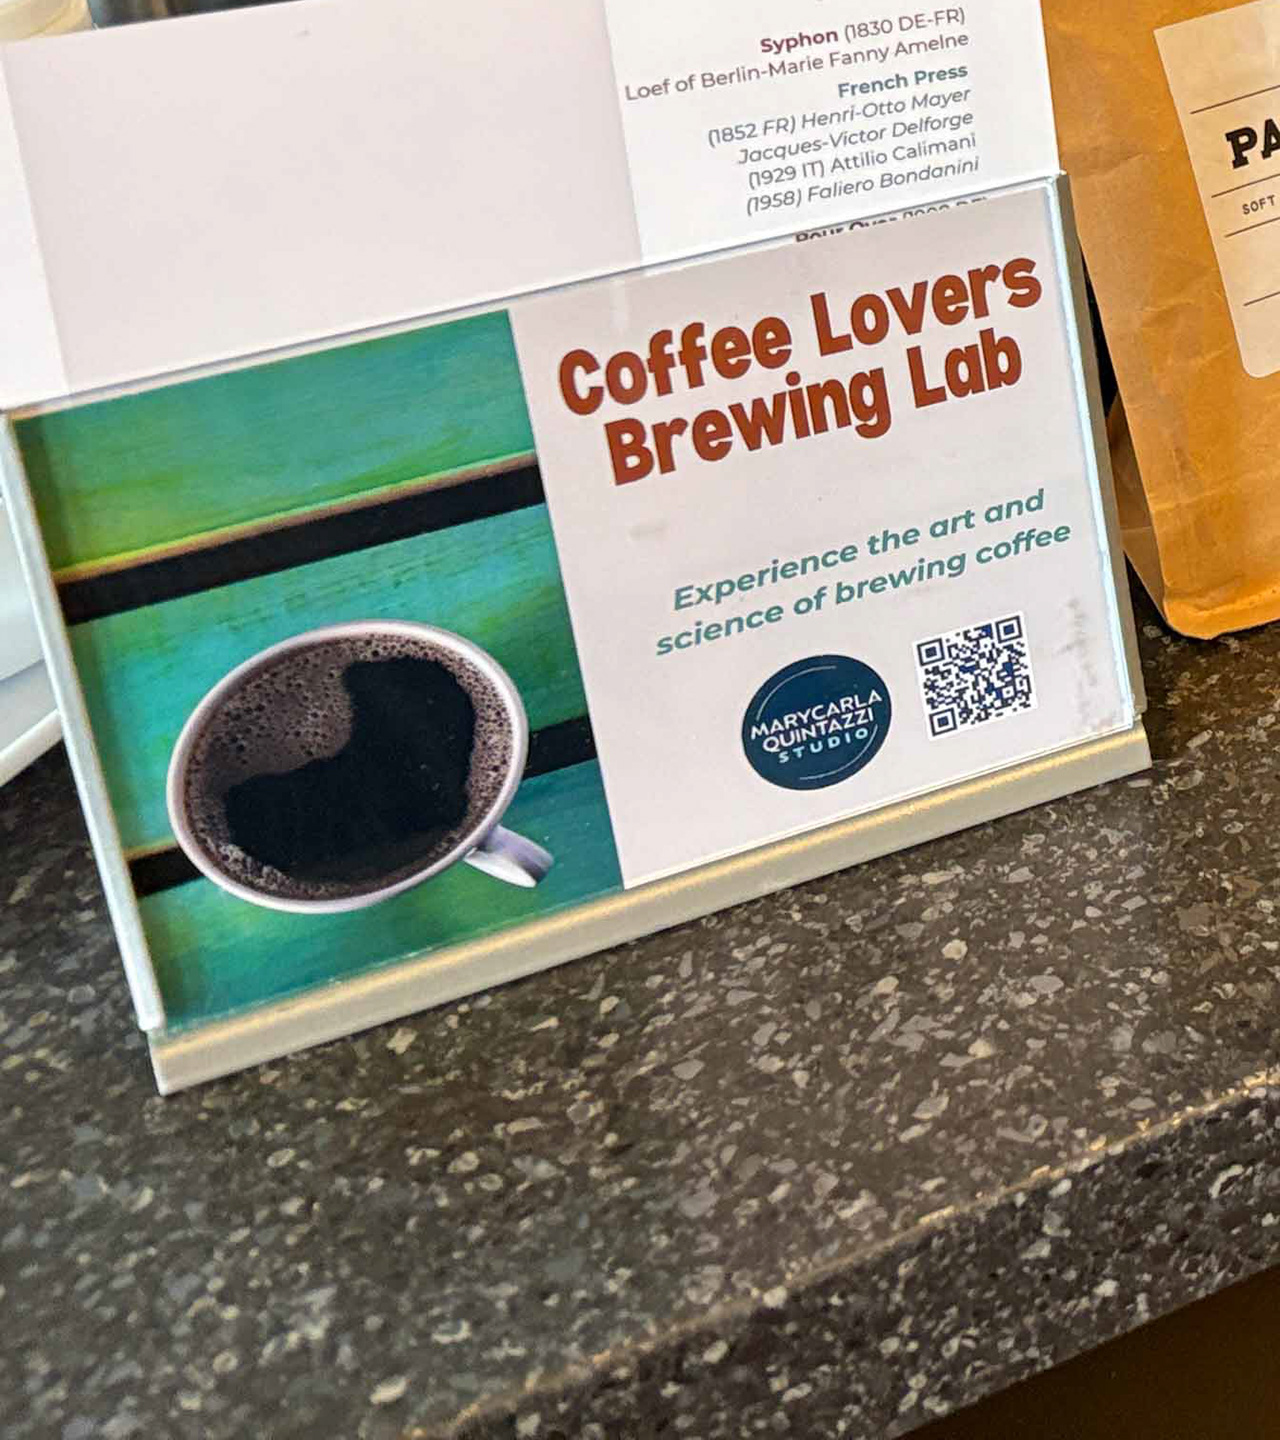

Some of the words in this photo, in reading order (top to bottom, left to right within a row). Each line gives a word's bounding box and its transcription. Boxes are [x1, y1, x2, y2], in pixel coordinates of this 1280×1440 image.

[760, 30, 839, 55] Syphon
[844, 19, 893, 44] (1830
[898, 7, 966, 32] DE-FR)
[625, 78, 670, 101] Loef
[675, 74, 696, 92] of
[700, 56, 824, 89] Berlin-Marie
[829, 46, 890, 67] Fanny
[838, 73, 909, 98] French
[914, 65, 969, 86] Press
[708, 123, 758, 148] (1852
[763, 116, 797, 137] FR)
[801, 99, 907, 130] Henri-Otto
[911, 87, 971, 111] Mayer
[737, 126, 887, 165] Jacques-Victor
[891, 111, 975, 138] Delforge
[746, 188, 802, 217] (1958)
[807, 175, 875, 202] Faliero
[879, 156, 980, 189] Bondanini
[748, 165, 797, 190] (1929
[802, 160, 826, 178] IT)
[830, 151, 888, 174] Attilio
[892, 132, 977, 161] Calimani
[1242, 194, 1276, 216] SOFT
[559, 315, 793, 416] Coffee
[810, 257, 1043, 357] Lovers
[604, 366, 892, 487] Brewing
[905, 327, 1022, 409] Lab
[673, 543, 859, 611] Experience
[866, 527, 920, 557] the
[928, 508, 976, 539] art
[984, 488, 1046, 523] and
[656, 604, 784, 656] science
[793, 586, 829, 616] of
[835, 550, 967, 606] brewing
[975, 522, 1071, 565] coffee
[751, 688, 883, 740] MARYCARLA
[762, 707, 874, 753] QUINTAZZI
[778, 727, 869, 763] STUDIO
